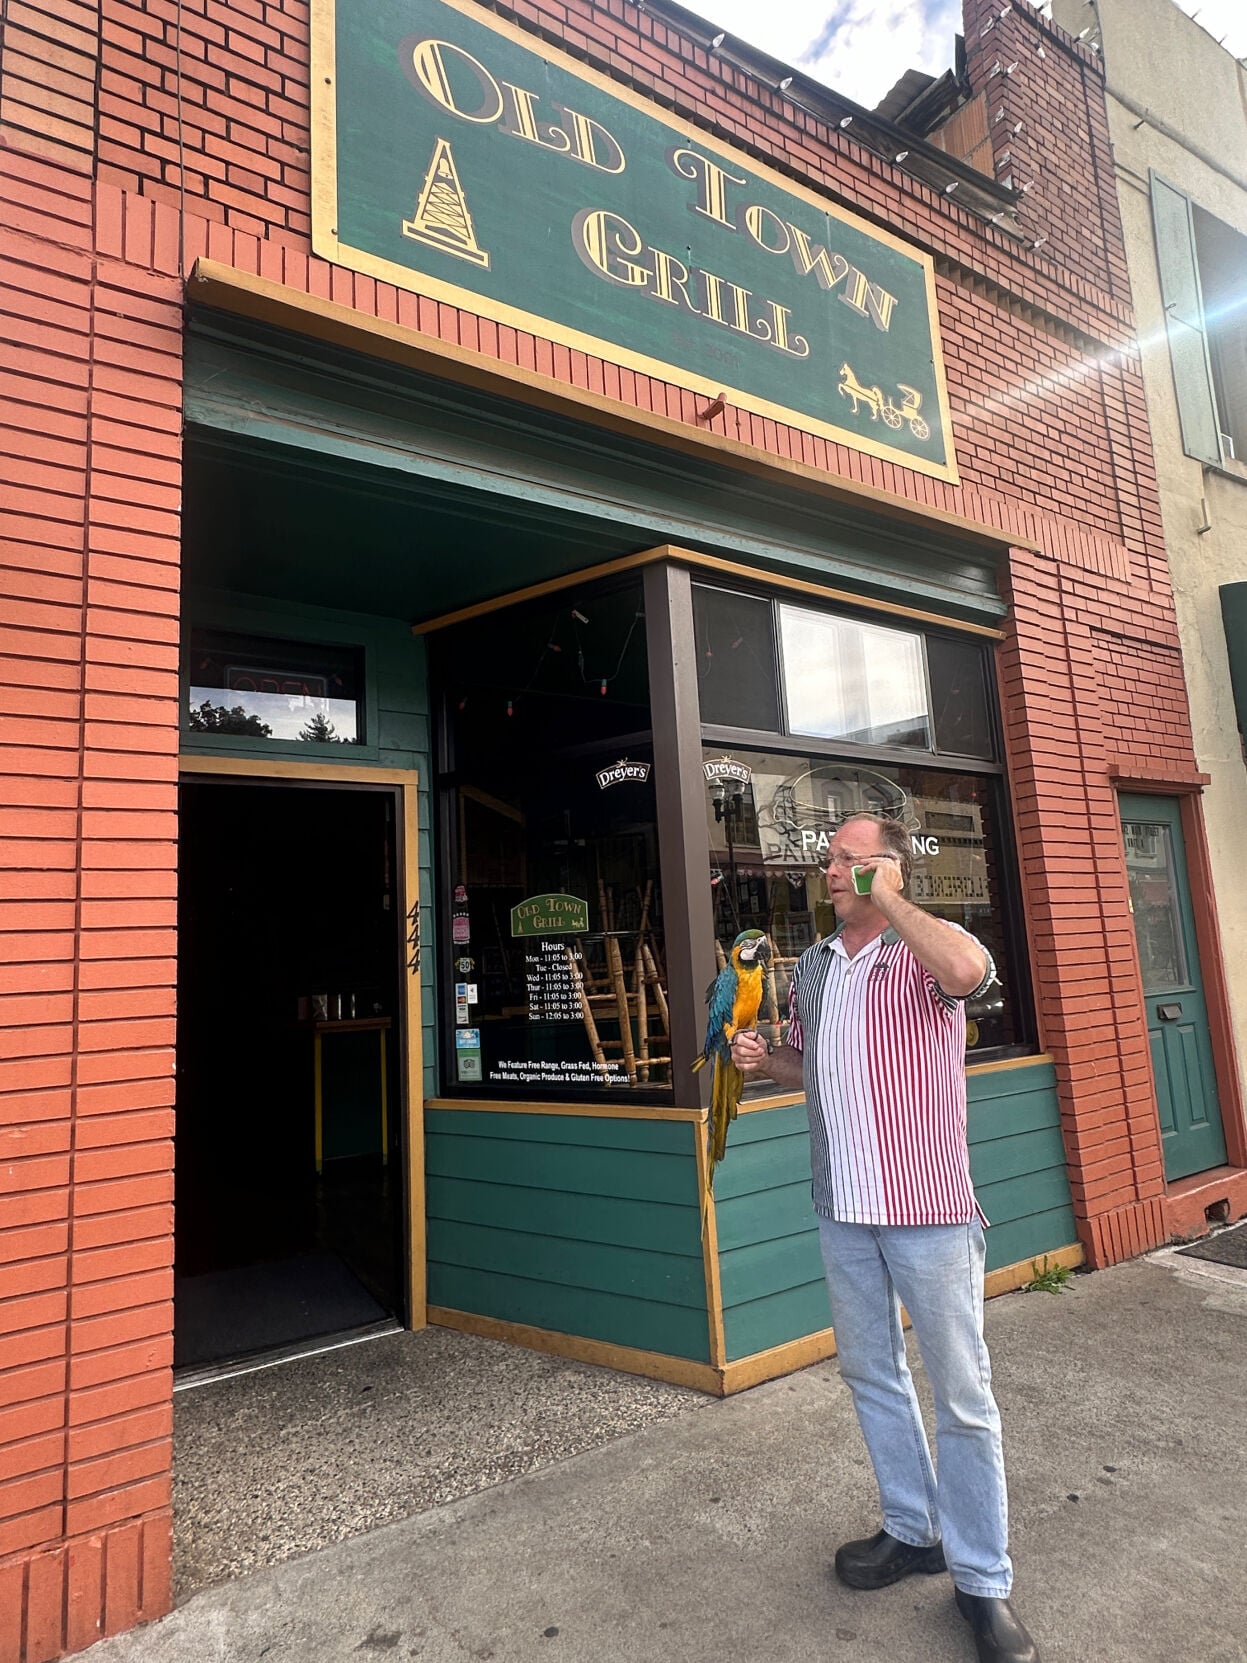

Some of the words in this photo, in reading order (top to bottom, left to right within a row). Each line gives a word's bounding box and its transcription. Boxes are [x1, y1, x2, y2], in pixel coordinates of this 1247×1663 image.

[408, 37, 626, 175] OLD
[672, 148, 899, 333] TOWN
[577, 209, 810, 358] GRILL
[599, 764, 647, 787] Dreyer's
[705, 761, 749, 781] Dreyer's
[801, 830, 837, 851] PA
[911, 835, 940, 856] NG
[517, 904, 540, 919] OLD
[545, 898, 582, 915] TOWN
[533, 915, 566, 929] GRILL
[406, 900, 421, 975] 444
[541, 941, 565, 951] Hours
[461, 961, 470, 970] 50
[526, 974, 540, 982] Wed
[545, 973, 561, 981] 11:05
[568, 992, 582, 1000] 3:00
[545, 1002, 560, 1010] 11:05
[569, 1002, 583, 1010] 3:00
[528, 1012, 540, 1020] Sun
[546, 1012, 562, 1020] 12:05
[498, 1060, 507, 1069] We
[508, 1060, 527, 1069] Feature
[528, 1061, 540, 1069] Free
[541, 1061, 560, 1071] Range,
[561, 1061, 578, 1070] Grass
[578, 1061, 591, 1070] Fed,
[592, 1062, 619, 1070] Hormone
[490, 1072, 501, 1080] Free
[502, 1072, 519, 1080] Meats,
[520, 1072, 540, 1082] Organic
[542, 1072, 564, 1081] Produce
[565, 1073, 570, 1081] &
[570, 1073, 590, 1081] Gluten
[591, 1073, 604, 1081] Free
[604, 1073, 630, 1083] Options!
